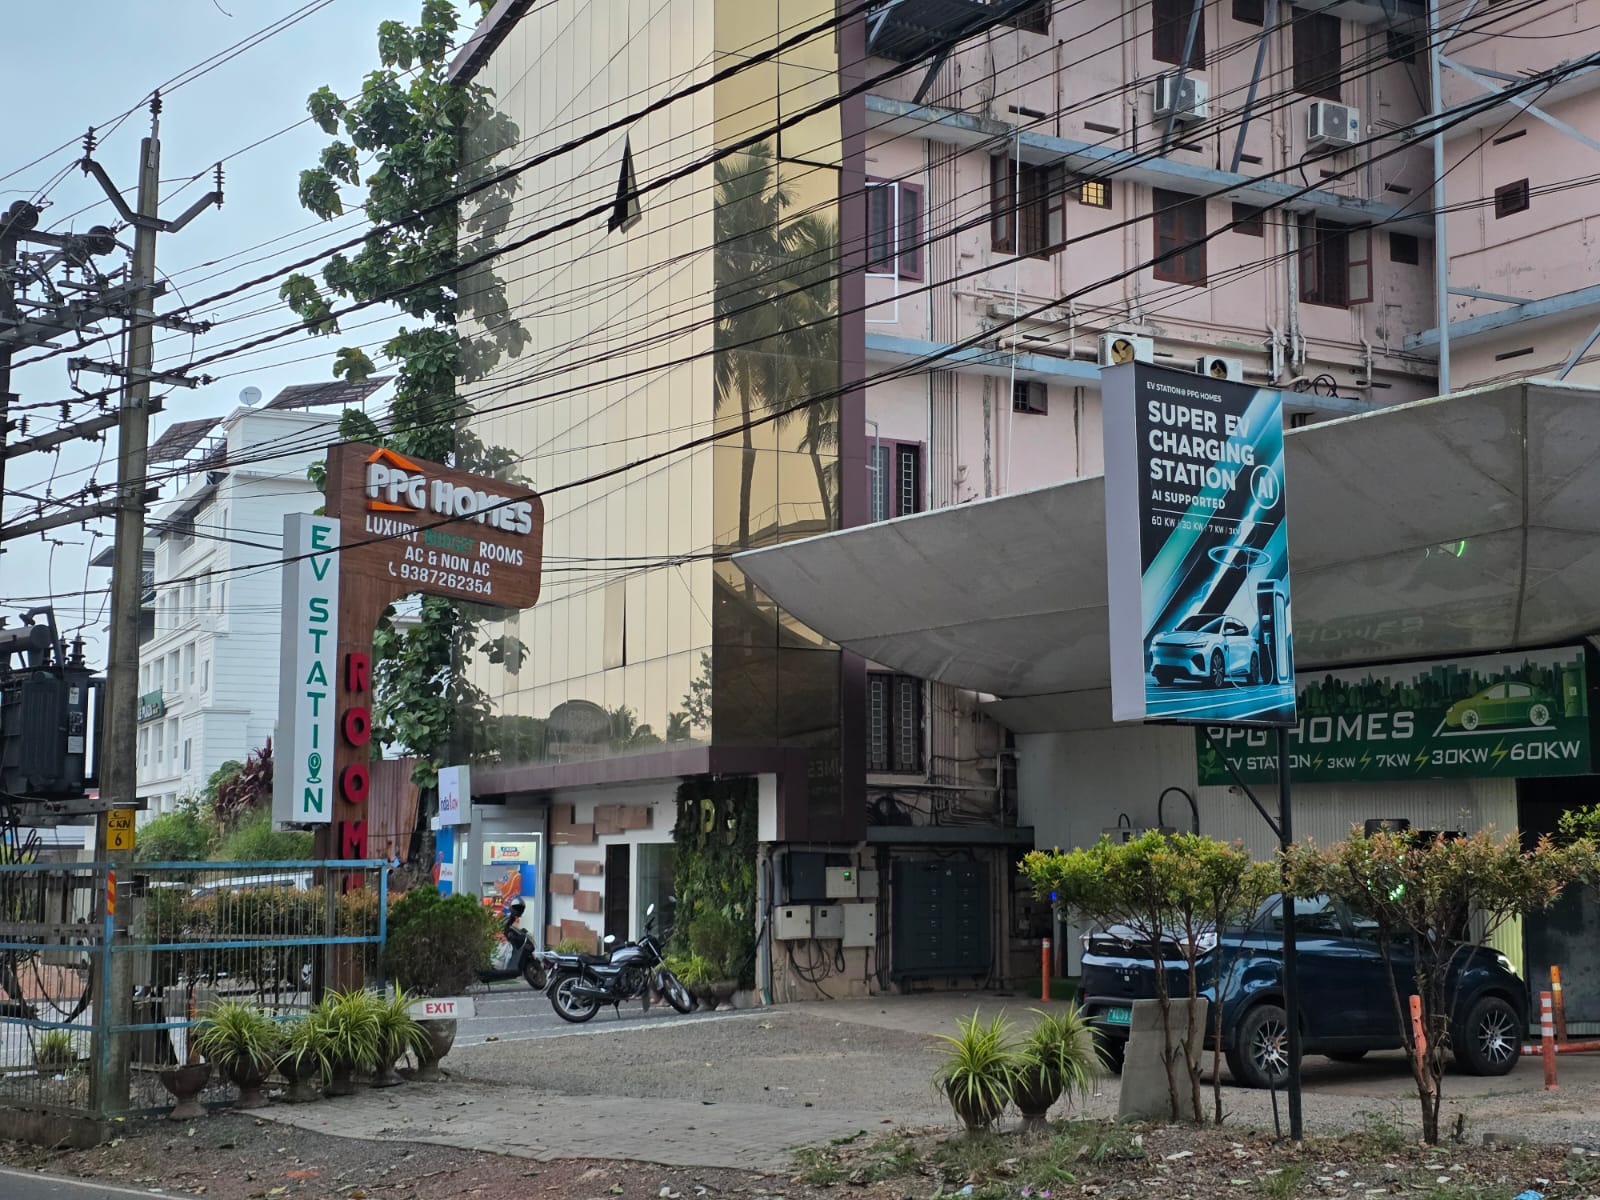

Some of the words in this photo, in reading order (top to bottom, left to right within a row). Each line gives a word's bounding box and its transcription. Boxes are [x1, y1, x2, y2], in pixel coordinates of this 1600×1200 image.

[1146, 381, 1155, 390] EV
[1187, 389, 1199, 399] PPG
[1200, 392, 1222, 403] HOMES
[1148, 400, 1217, 434] SUPER
[1225, 414, 1250, 438] EV
[1149, 429, 1255, 466] CHARGING
[1150, 458, 1236, 491] STATION
[1257, 476, 1273, 499] AI
[366, 463, 427, 510] PPG
[430, 479, 533, 536] HOMES
[1152, 489, 1162, 500] AI
[1164, 491, 1226, 509] SUPPORTED
[1152, 516, 1162, 526] 60
[1164, 518, 1175, 528] KW
[310, 525, 331, 582] EV
[365, 514, 419, 543] LUXURY
[424, 529, 475, 553] BUDGET
[479, 541, 523, 566] ROOMS
[405, 546, 423, 563] AC
[428, 551, 437, 566] &
[441, 553, 469, 572] NON
[473, 561, 490, 577] AC
[400, 563, 492, 595] 9387262354
[1247, 754, 1310, 769] STATON
[1327, 757, 1356, 768] 3KW
[1376, 753, 1410, 767] 7KW
[1431, 748, 1488, 765] 30KW
[1510, 740, 1580, 760] 60KW
[115, 832, 122, 846] 6
[425, 1002, 454, 1014] EXIT
